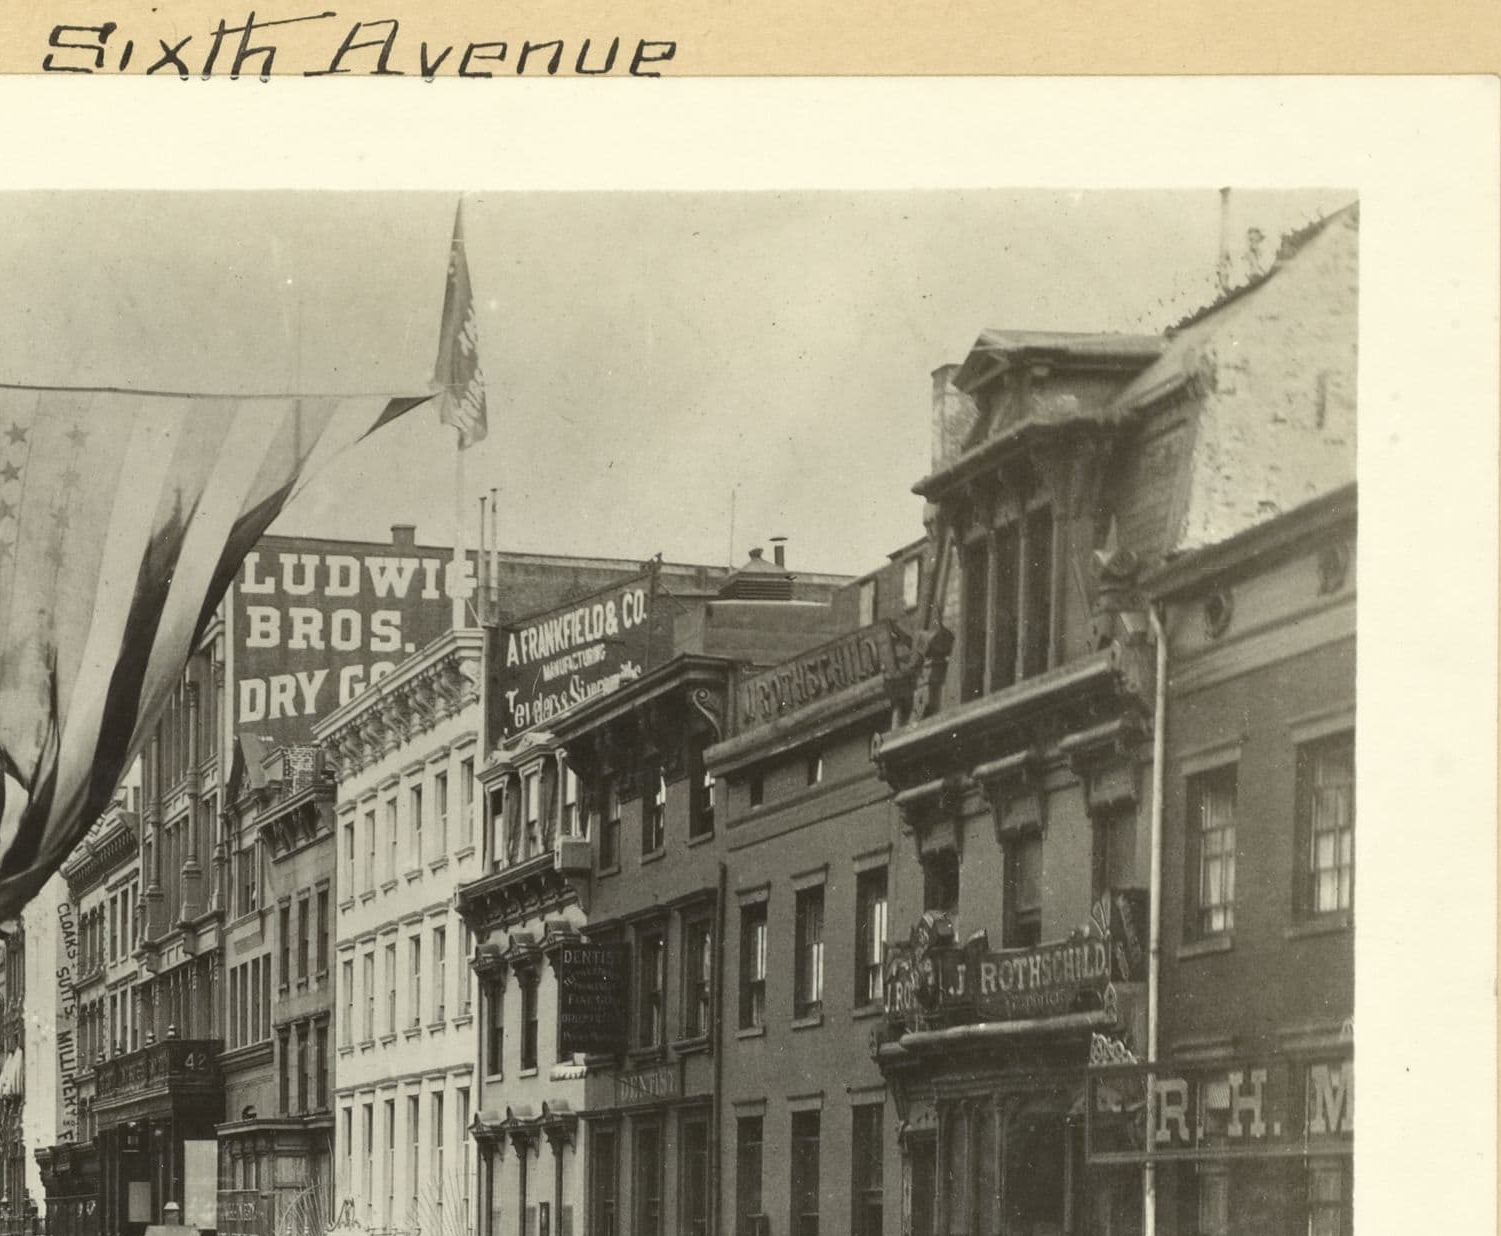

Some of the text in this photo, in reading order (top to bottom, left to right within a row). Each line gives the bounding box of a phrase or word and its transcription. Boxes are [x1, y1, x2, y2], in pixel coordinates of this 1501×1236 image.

[43, 8, 336, 82] Sixth
[303, 19, 676, 82] Avenue
[246, 605, 416, 653] BROS.
[520, 603, 605, 665] FRANKFIELD
[605, 600, 619, 636] &
[238, 669, 330, 724] DRY
